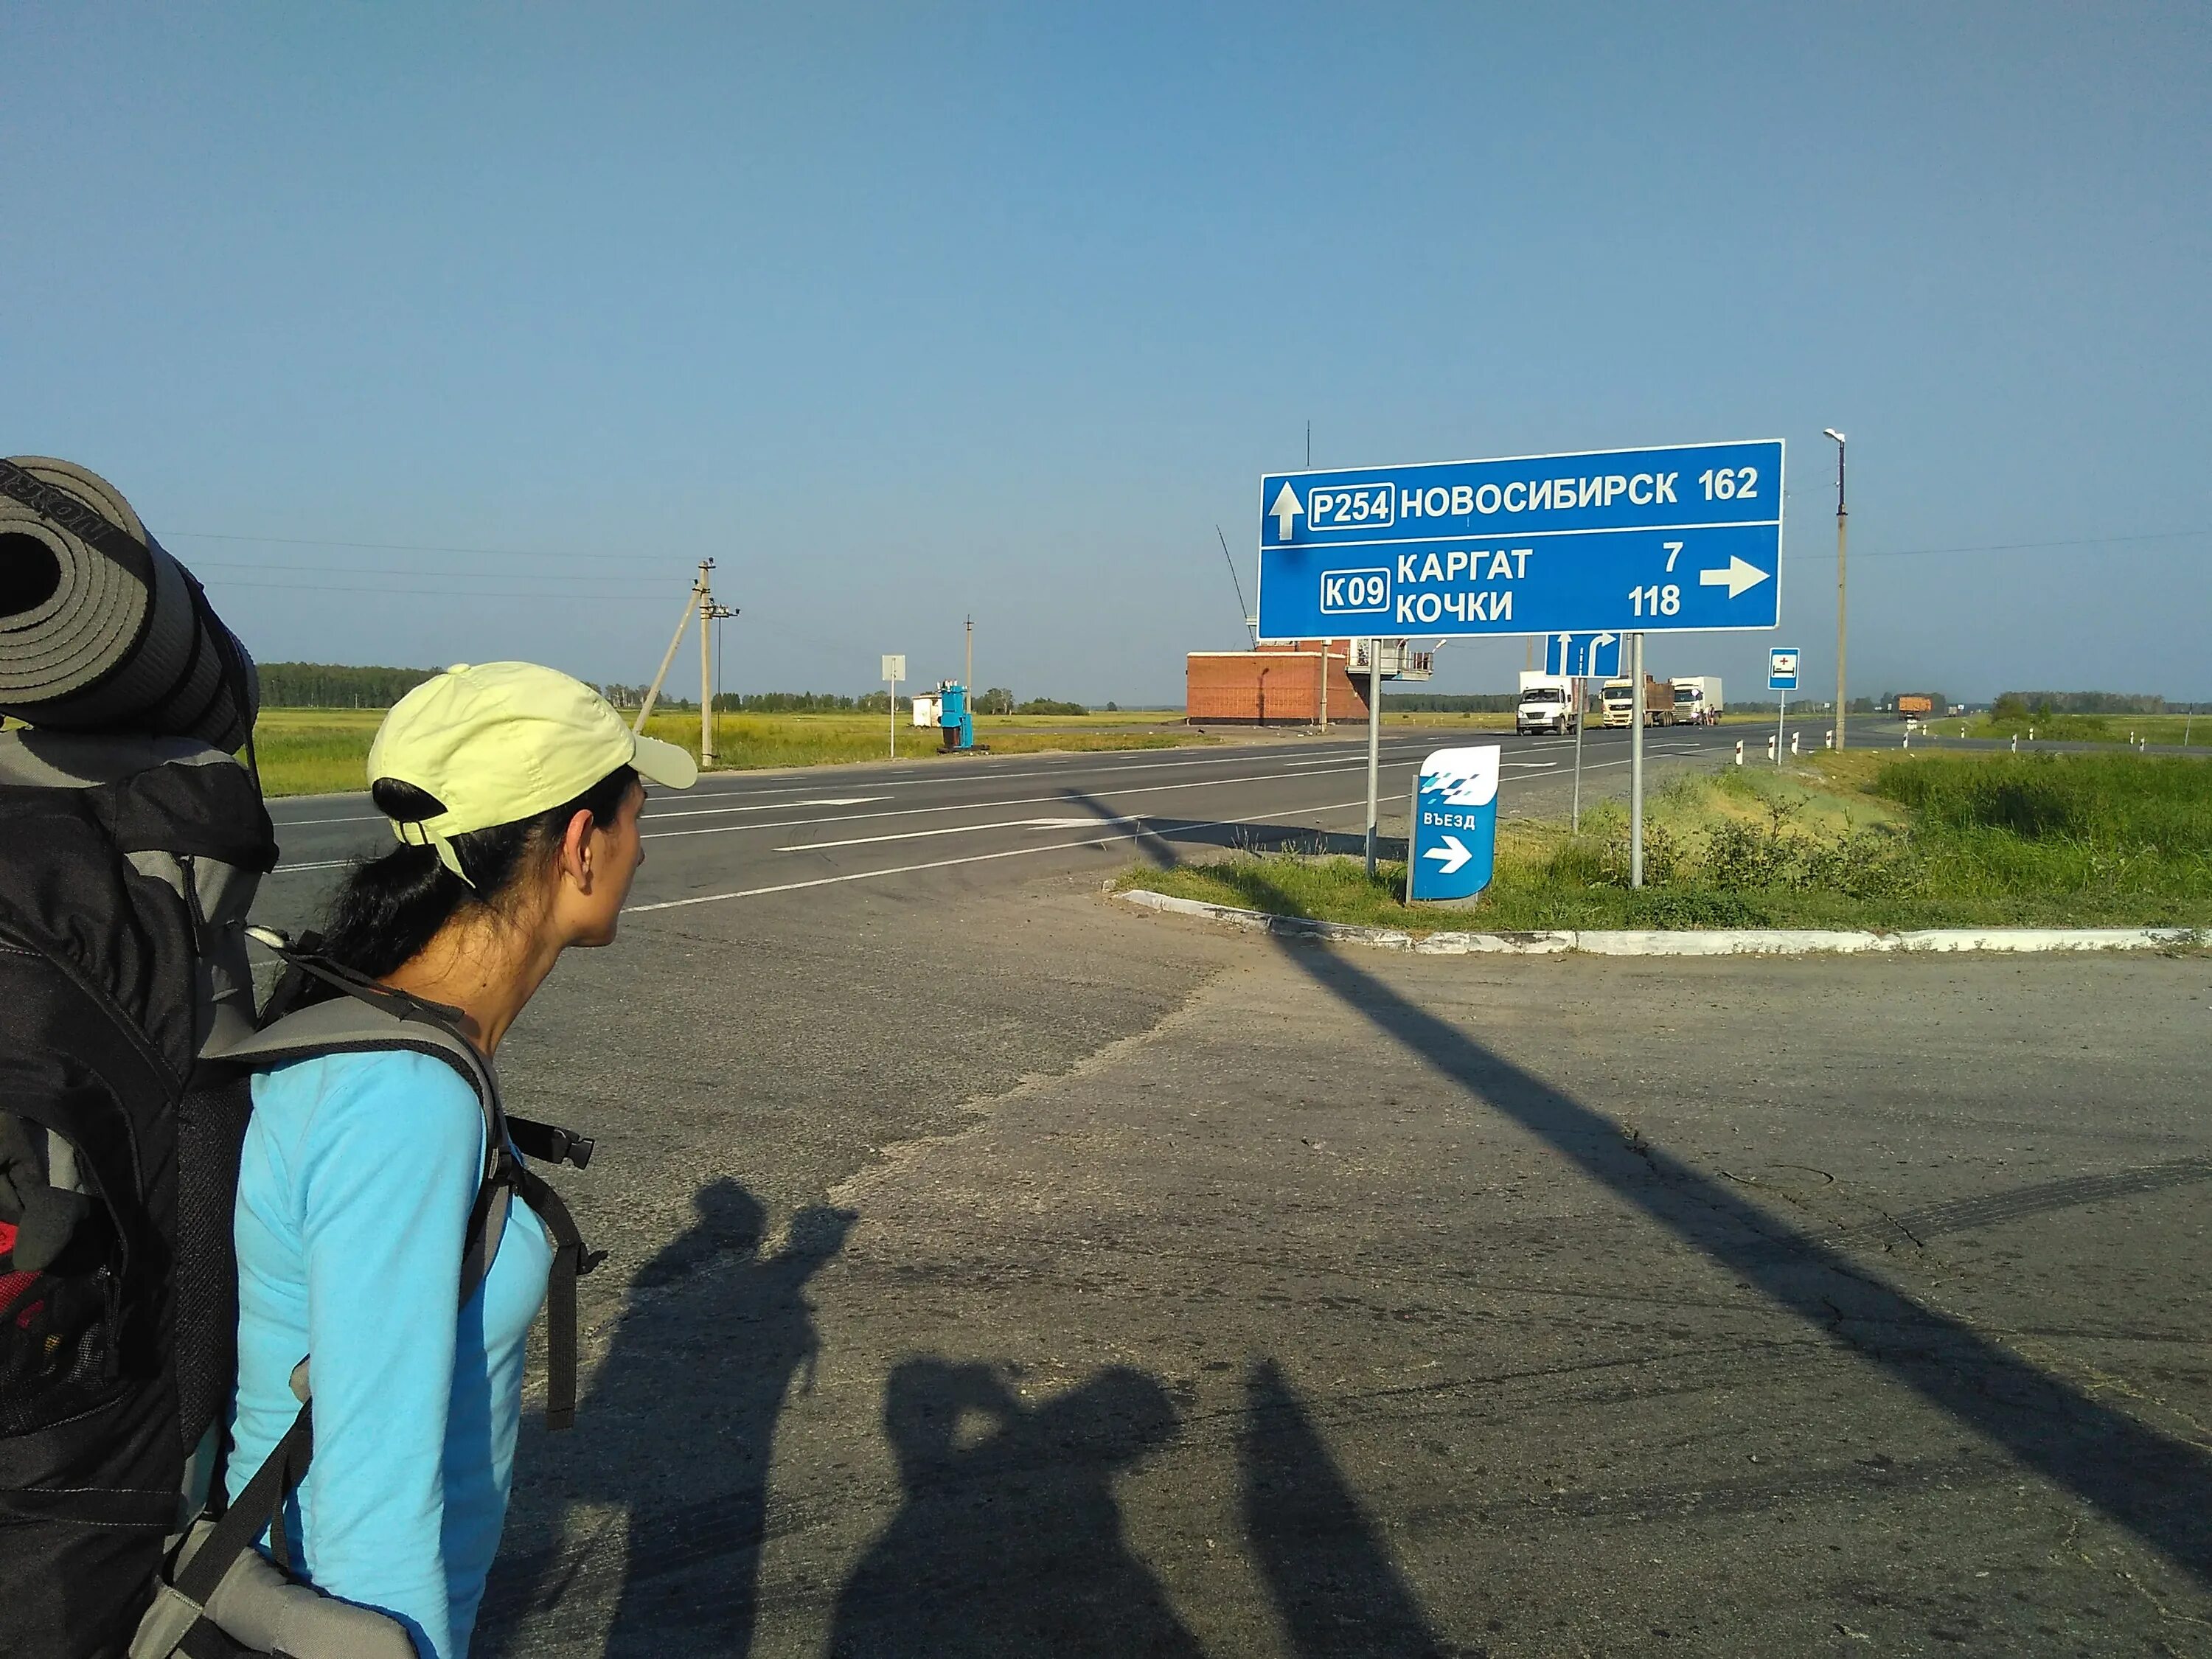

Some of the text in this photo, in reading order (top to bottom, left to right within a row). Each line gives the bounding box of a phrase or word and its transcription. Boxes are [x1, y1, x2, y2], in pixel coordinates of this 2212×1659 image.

[1313, 467, 1758, 524] Р254 НОВОСИБИРСК 162
[1397, 541, 1683, 583] КАРГАТ 7
[1326, 576, 1384, 606] К09
[1397, 584, 1680, 623] КОЧКИ 118
[1423, 812, 1475, 830] ВЪЕЗД
